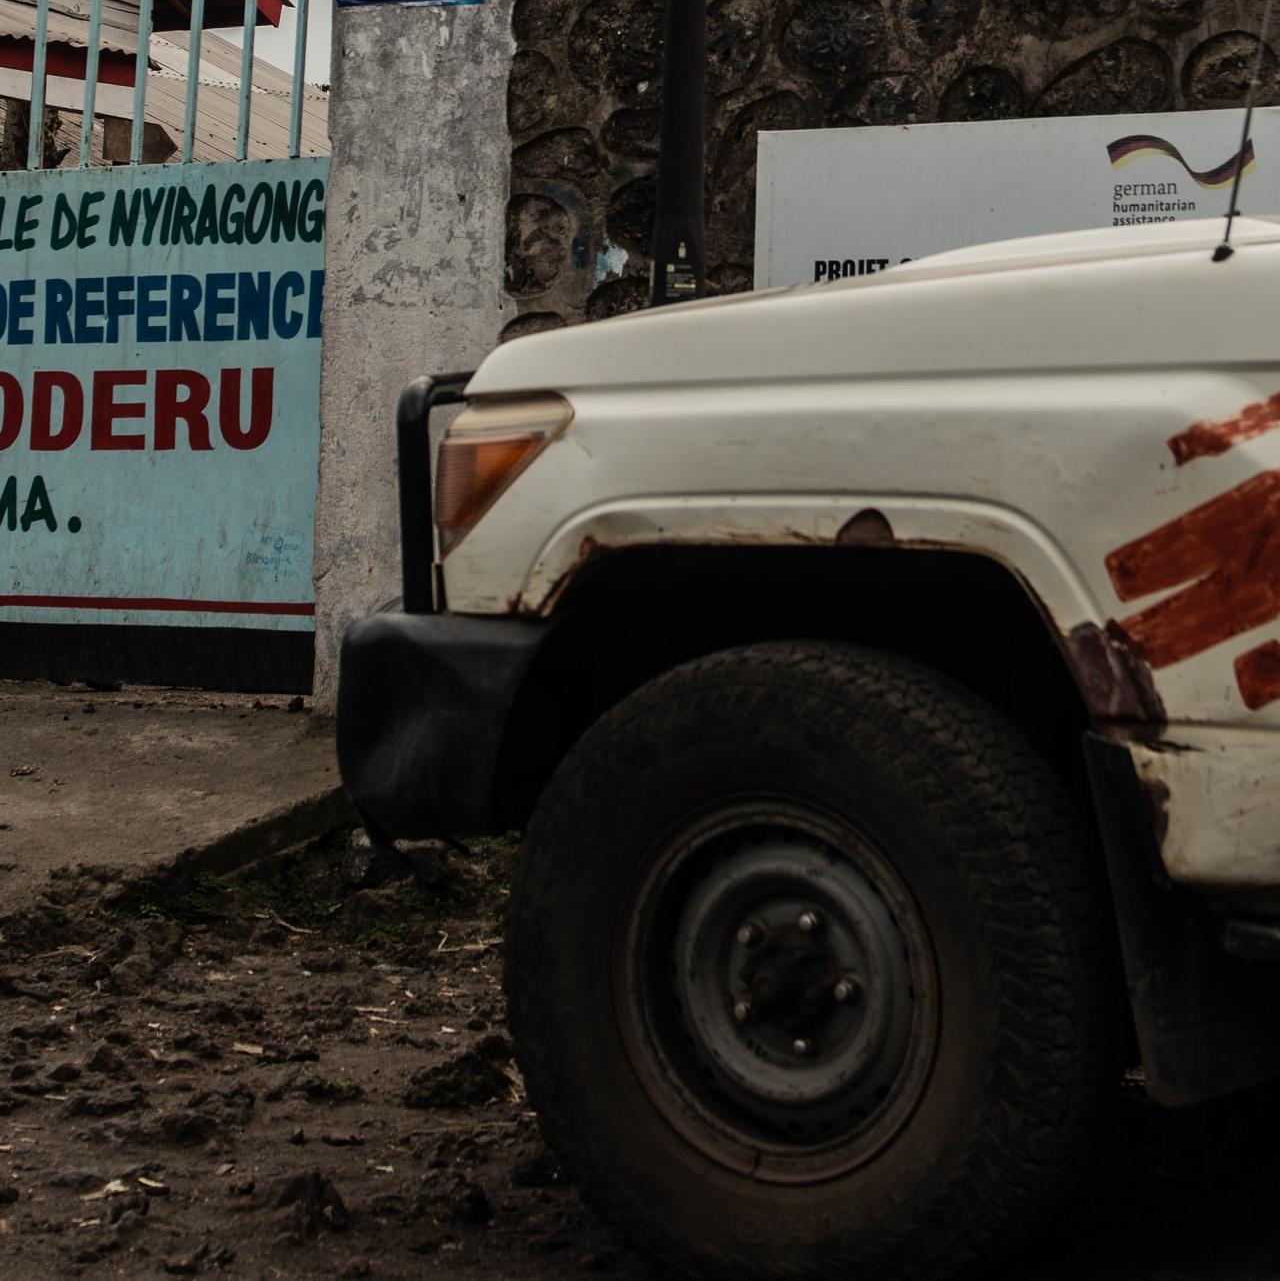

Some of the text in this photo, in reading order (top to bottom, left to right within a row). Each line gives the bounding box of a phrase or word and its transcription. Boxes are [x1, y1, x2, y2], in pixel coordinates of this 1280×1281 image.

[1113, 183, 1177, 200] german
[49, 191, 105, 250] DE
[109, 179, 325, 247] NYIRAGONG
[1113, 200, 1195, 212] humanitarian
